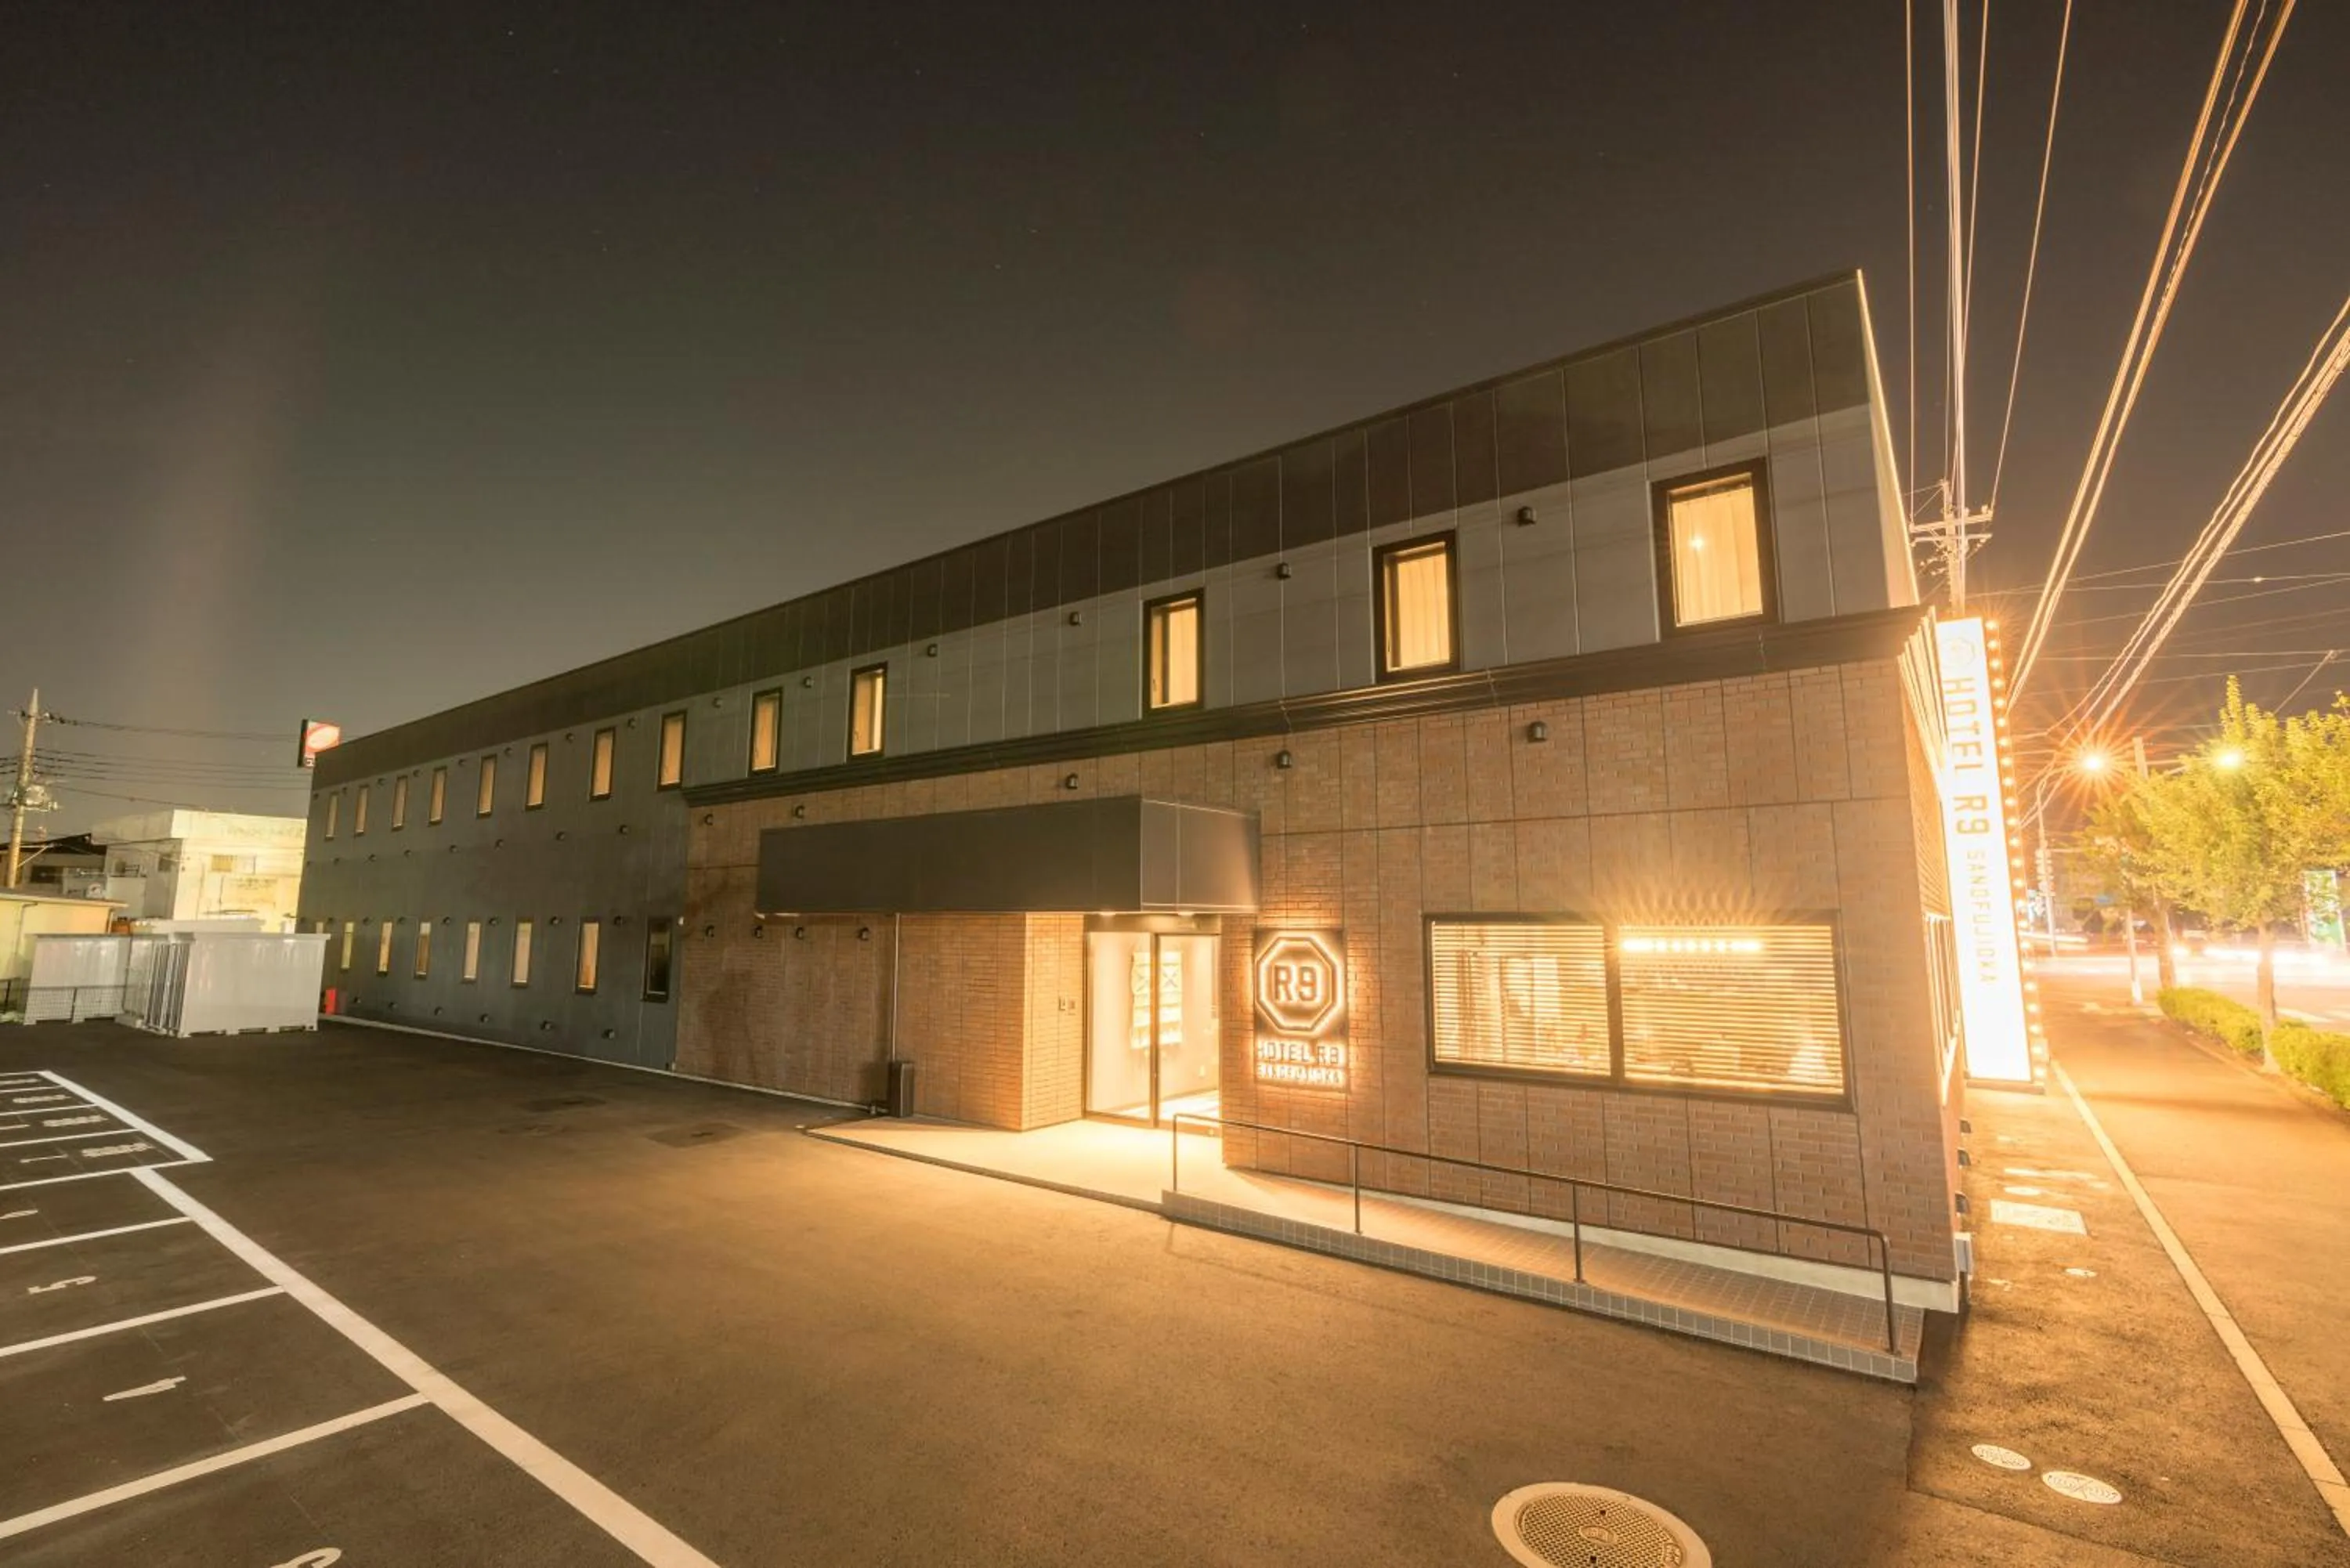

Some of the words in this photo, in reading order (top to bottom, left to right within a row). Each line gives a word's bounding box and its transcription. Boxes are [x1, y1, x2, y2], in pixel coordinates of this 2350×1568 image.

[1943, 677, 1983, 772] HOTEL
[1952, 795, 1990, 835] R9
[1966, 849, 1997, 984] SANOFUJIOKA
[1273, 964, 1318, 1002] R9
[1256, 1041, 1311, 1063] HOTEL
